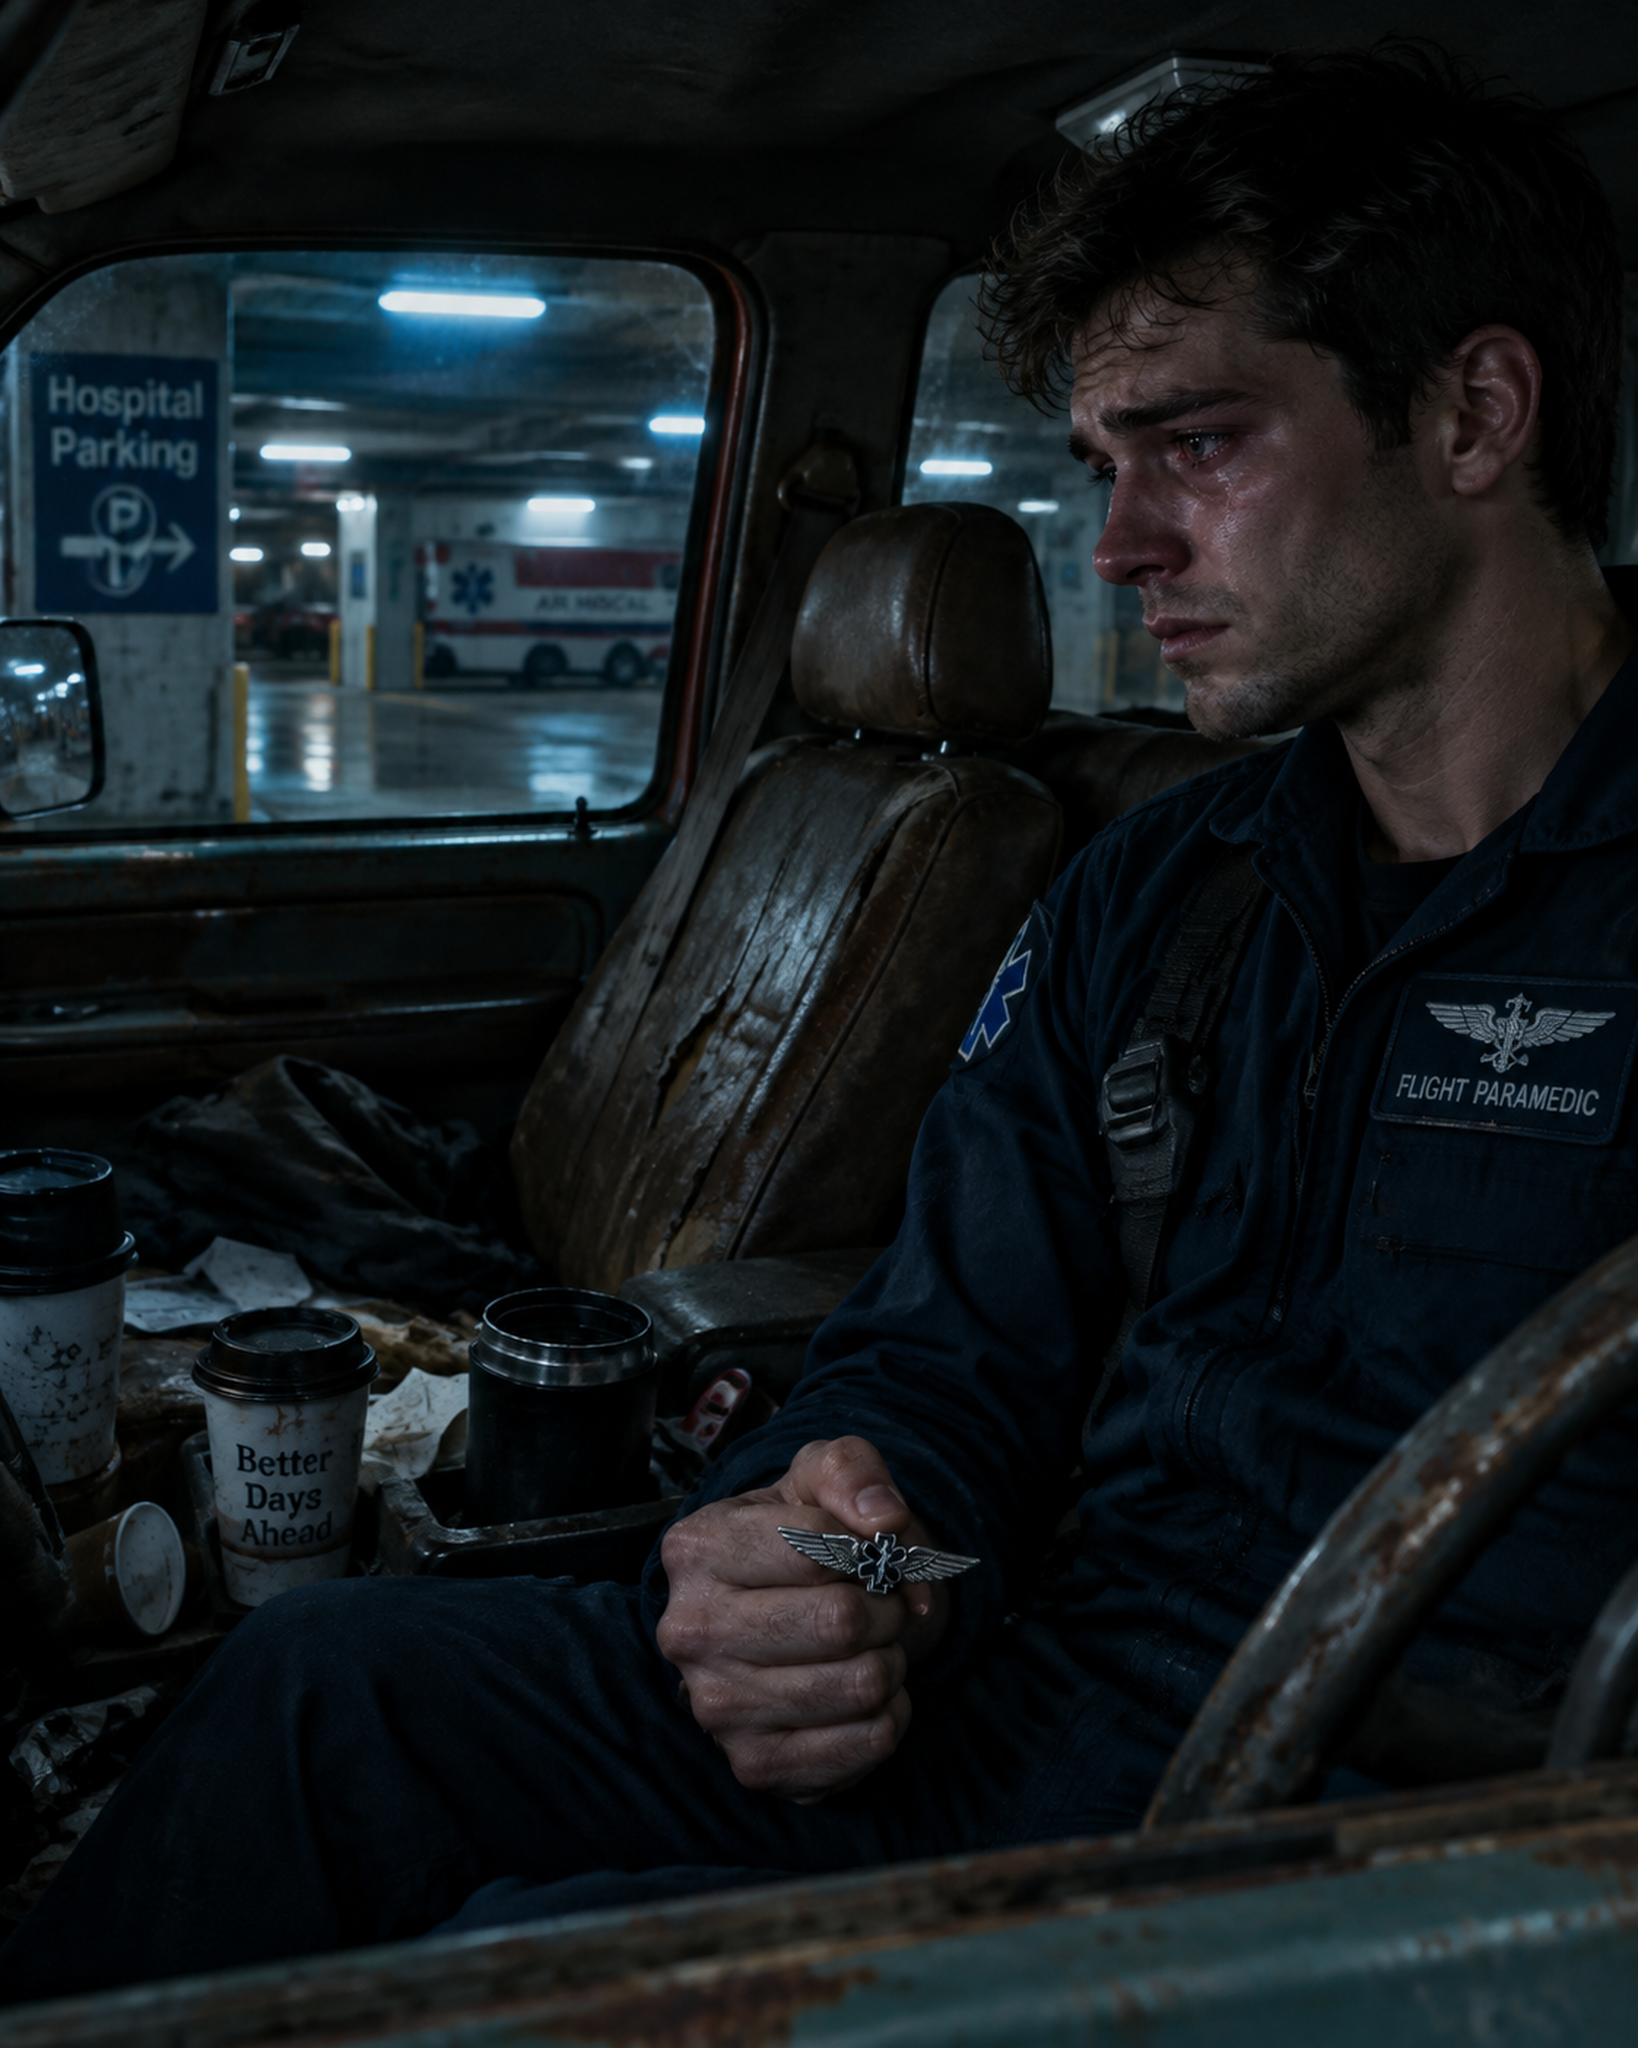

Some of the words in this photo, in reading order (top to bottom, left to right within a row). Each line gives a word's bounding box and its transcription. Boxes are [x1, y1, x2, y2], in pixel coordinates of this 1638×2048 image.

[49, 373, 204, 426] Hospital
[51, 426, 199, 480] Parking
[108, 497, 142, 535] P
[1395, 1073, 1470, 1103] FLIGHT
[1472, 1079, 1600, 1117] PARAMEDIC
[236, 1443, 333, 1476] Better
[245, 1482, 321, 1520] Days
[241, 1511, 332, 1546] Ahead
